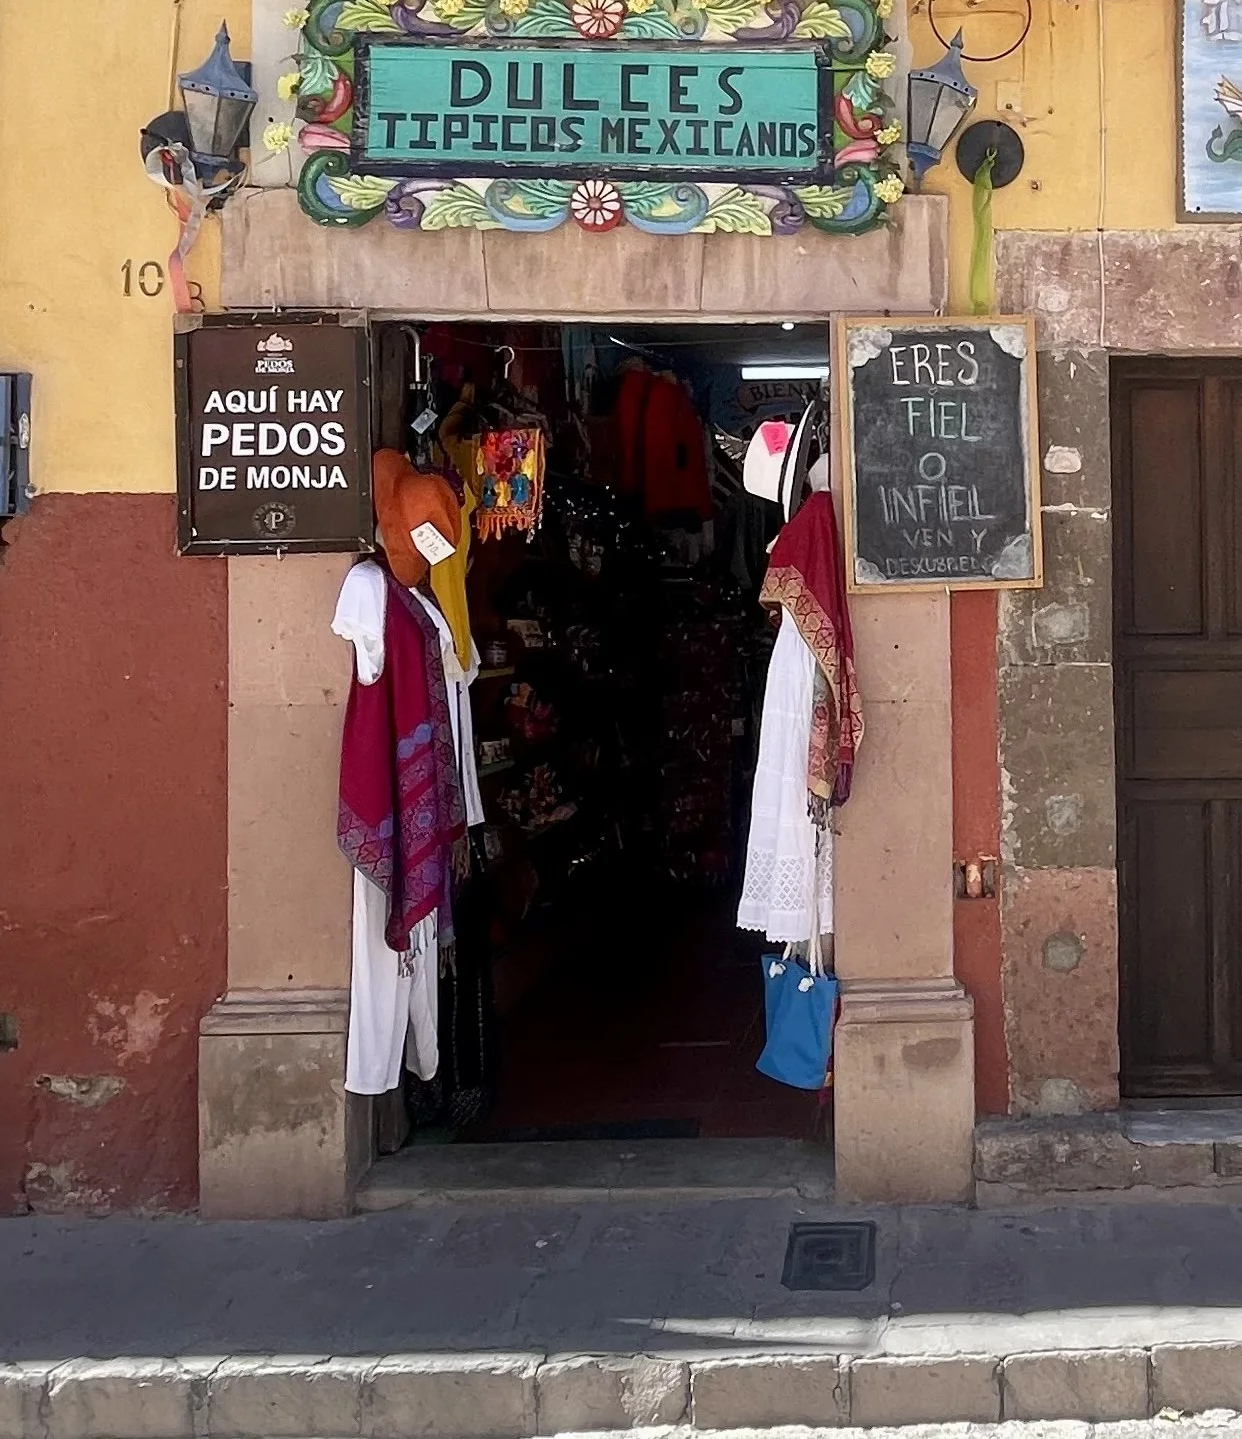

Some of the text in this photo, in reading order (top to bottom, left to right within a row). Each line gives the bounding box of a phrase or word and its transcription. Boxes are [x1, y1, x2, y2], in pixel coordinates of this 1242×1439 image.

[450, 59, 744, 115] DULCES
[377, 112, 817, 159] TIPICOS MEXICANOS
[889, 340, 980, 386] ERES
[203, 385, 344, 414] AQUÍ HAY
[899, 395, 982, 443] FIEL
[201, 421, 346, 457] PEDOS
[199, 465, 348, 490] DE MONJA
[919, 451, 946, 482] O
[878, 484, 996, 526] INFIEL
[902, 527, 988, 554] VEN Y
